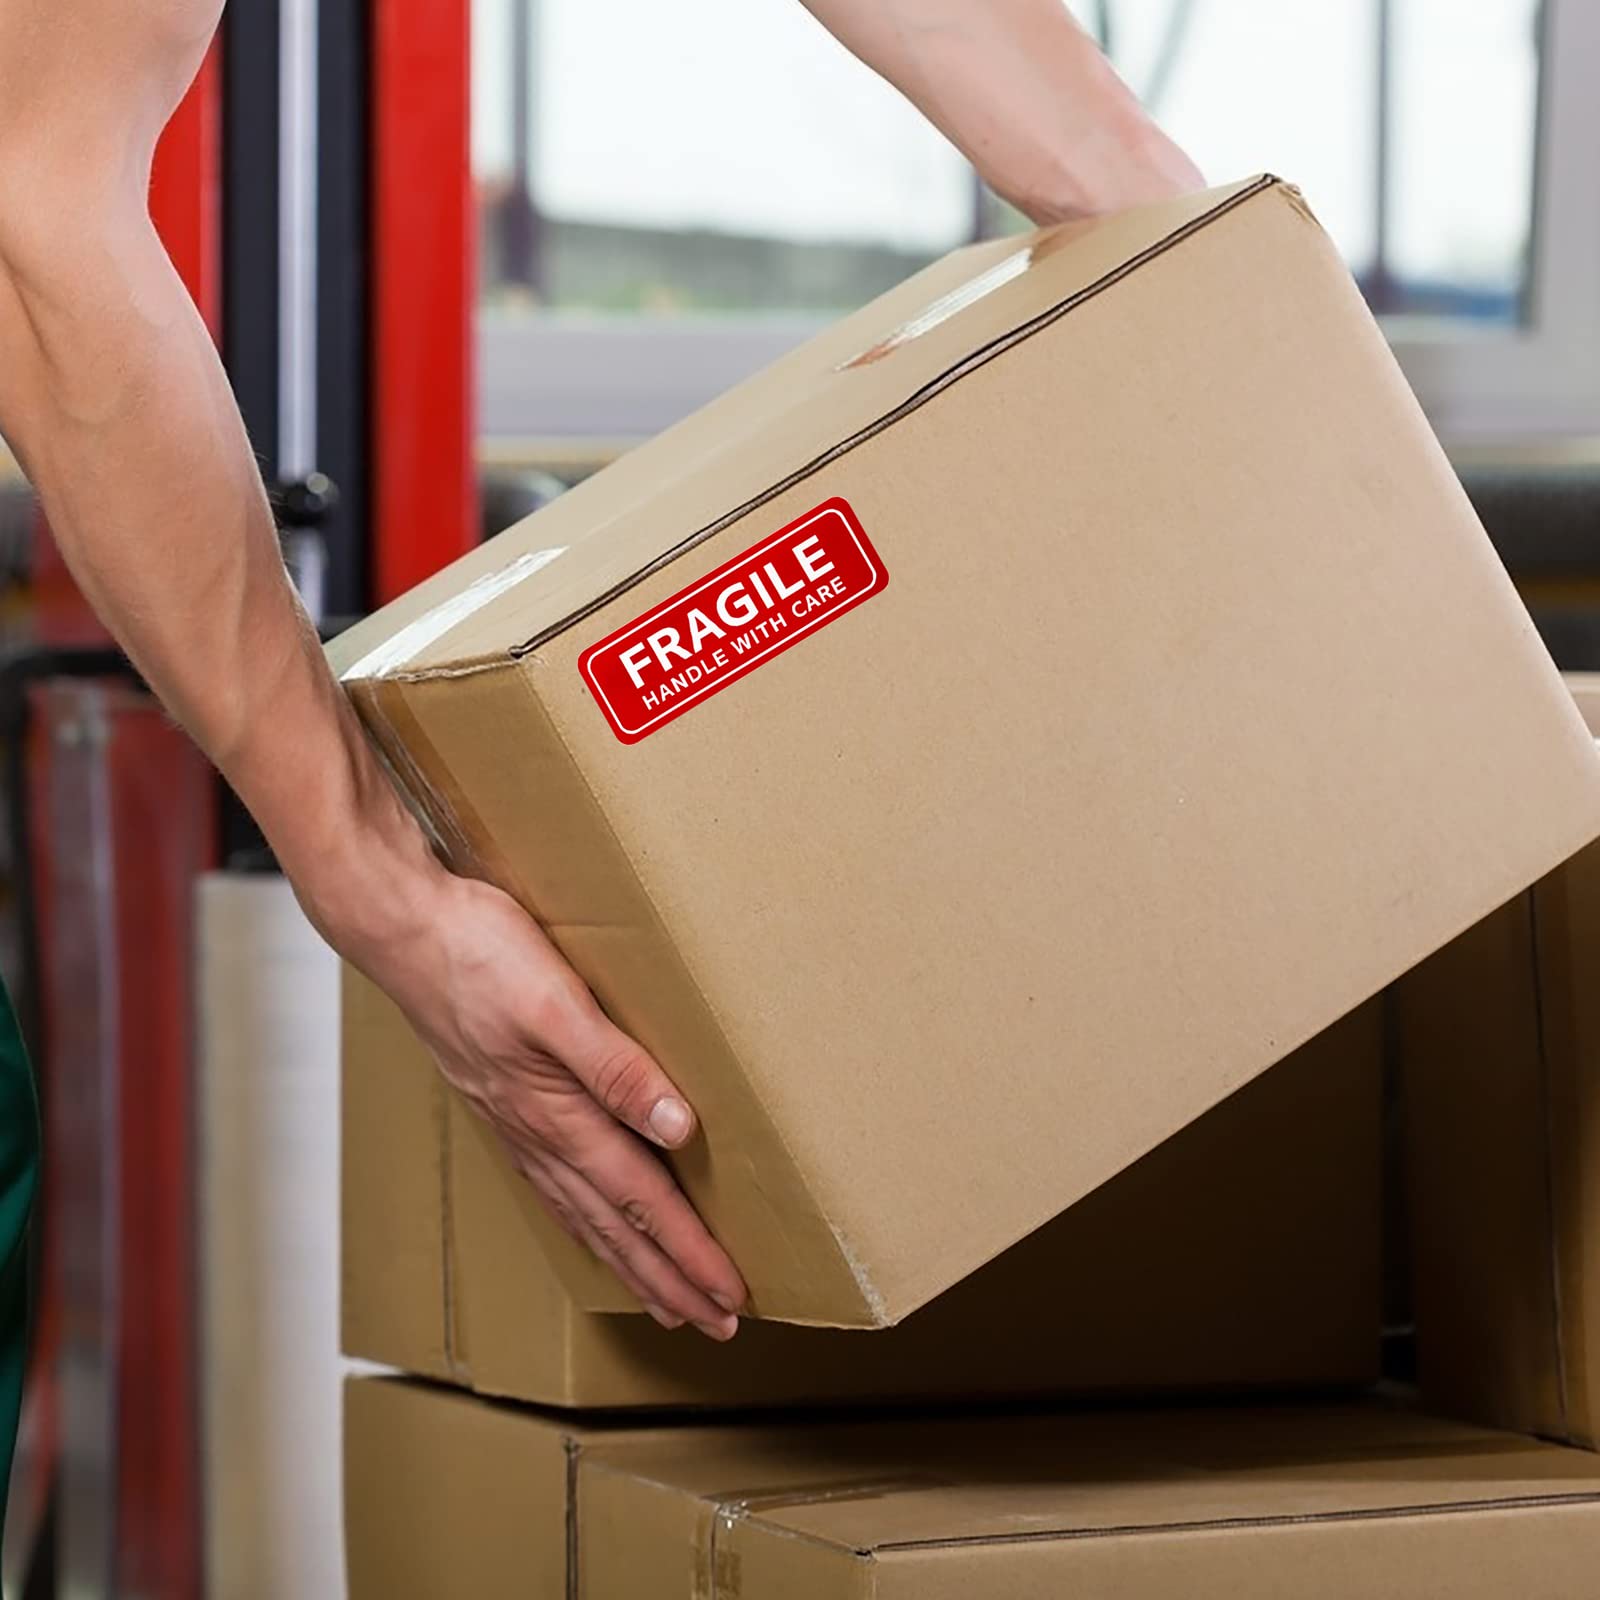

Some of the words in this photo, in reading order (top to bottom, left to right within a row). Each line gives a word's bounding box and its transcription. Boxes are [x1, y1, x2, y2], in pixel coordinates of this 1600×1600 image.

[618, 534, 835, 689] FRAGILE
[641, 648, 730, 711] HANDLE
[729, 612, 788, 655] WITH
[791, 575, 847, 618] CARE
